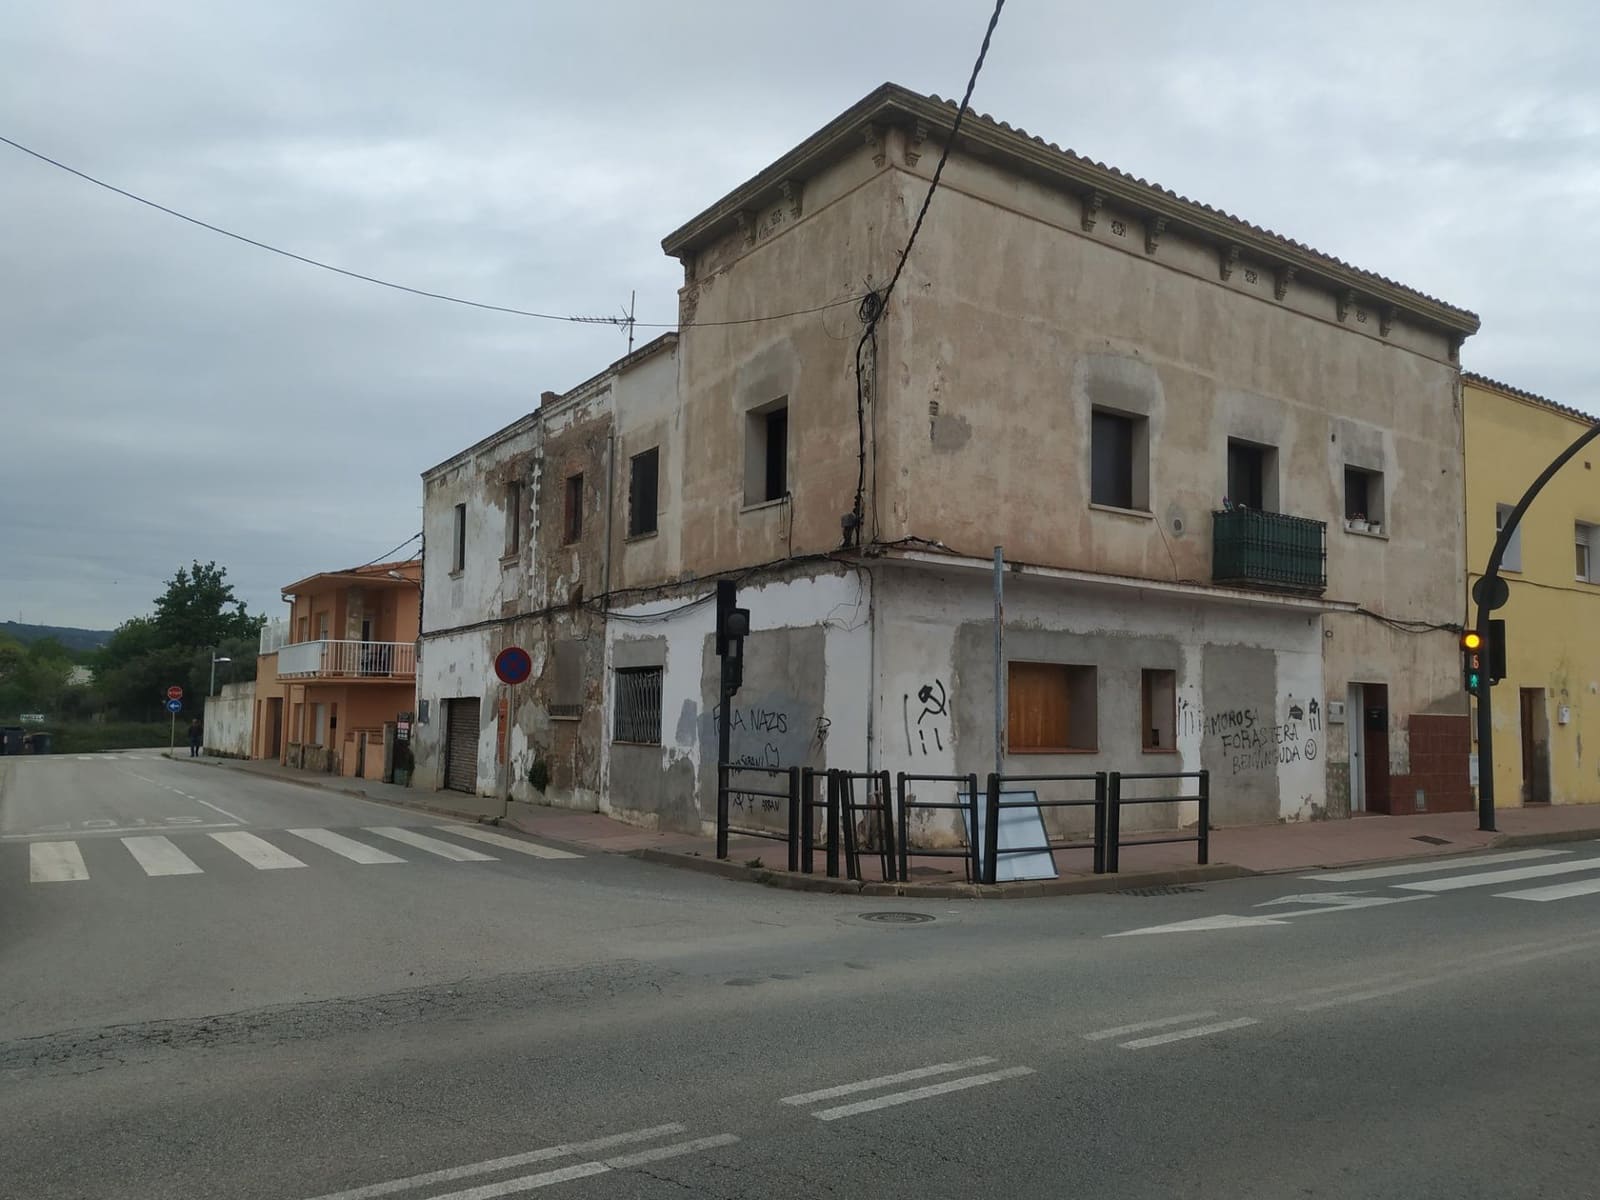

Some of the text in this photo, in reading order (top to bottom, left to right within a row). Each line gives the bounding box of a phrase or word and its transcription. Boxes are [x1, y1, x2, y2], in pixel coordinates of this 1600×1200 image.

[712, 703, 746, 736] FA
[750, 709, 788, 734] NAZIS
[1221, 723, 1299, 757] FORASTERA
